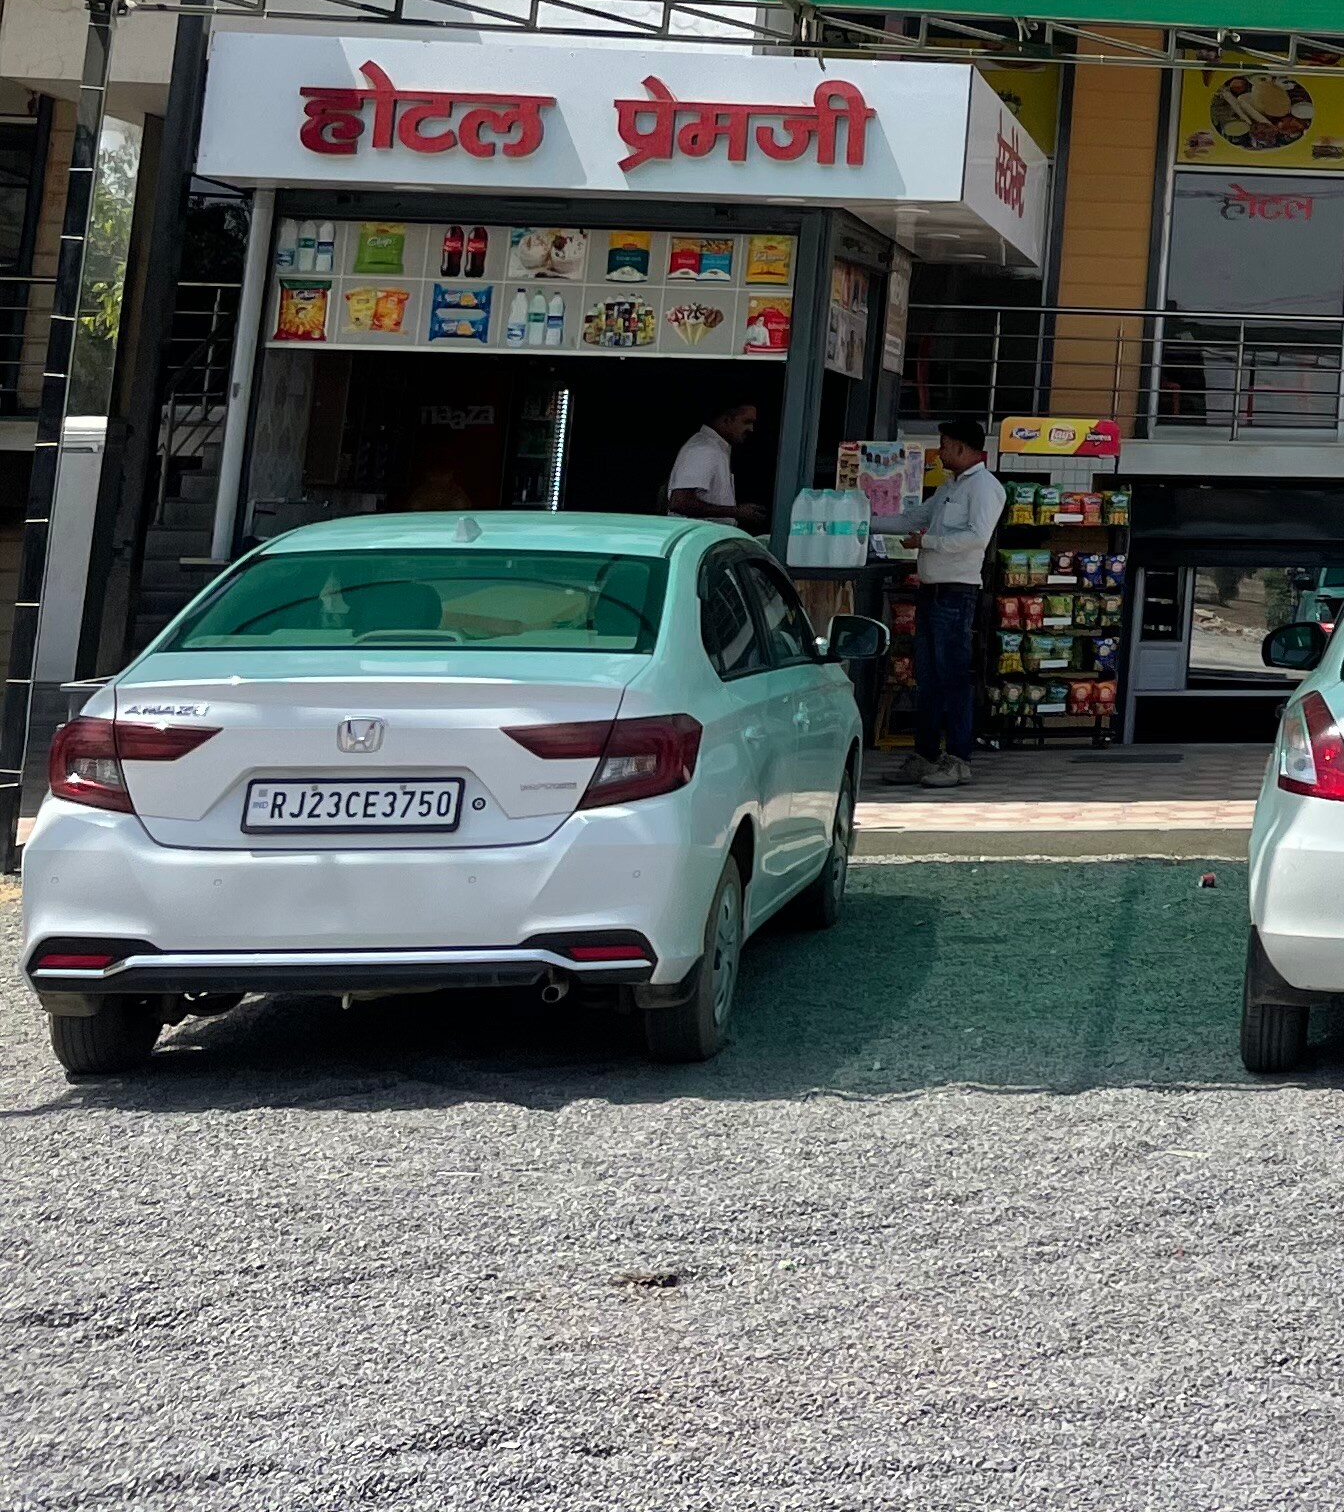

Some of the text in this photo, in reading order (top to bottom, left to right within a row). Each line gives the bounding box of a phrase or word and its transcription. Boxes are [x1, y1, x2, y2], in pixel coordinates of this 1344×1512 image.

[300, 59, 878, 173] होटल प्रेमजी
[270, 791, 451, 819] RJ23CE3750
